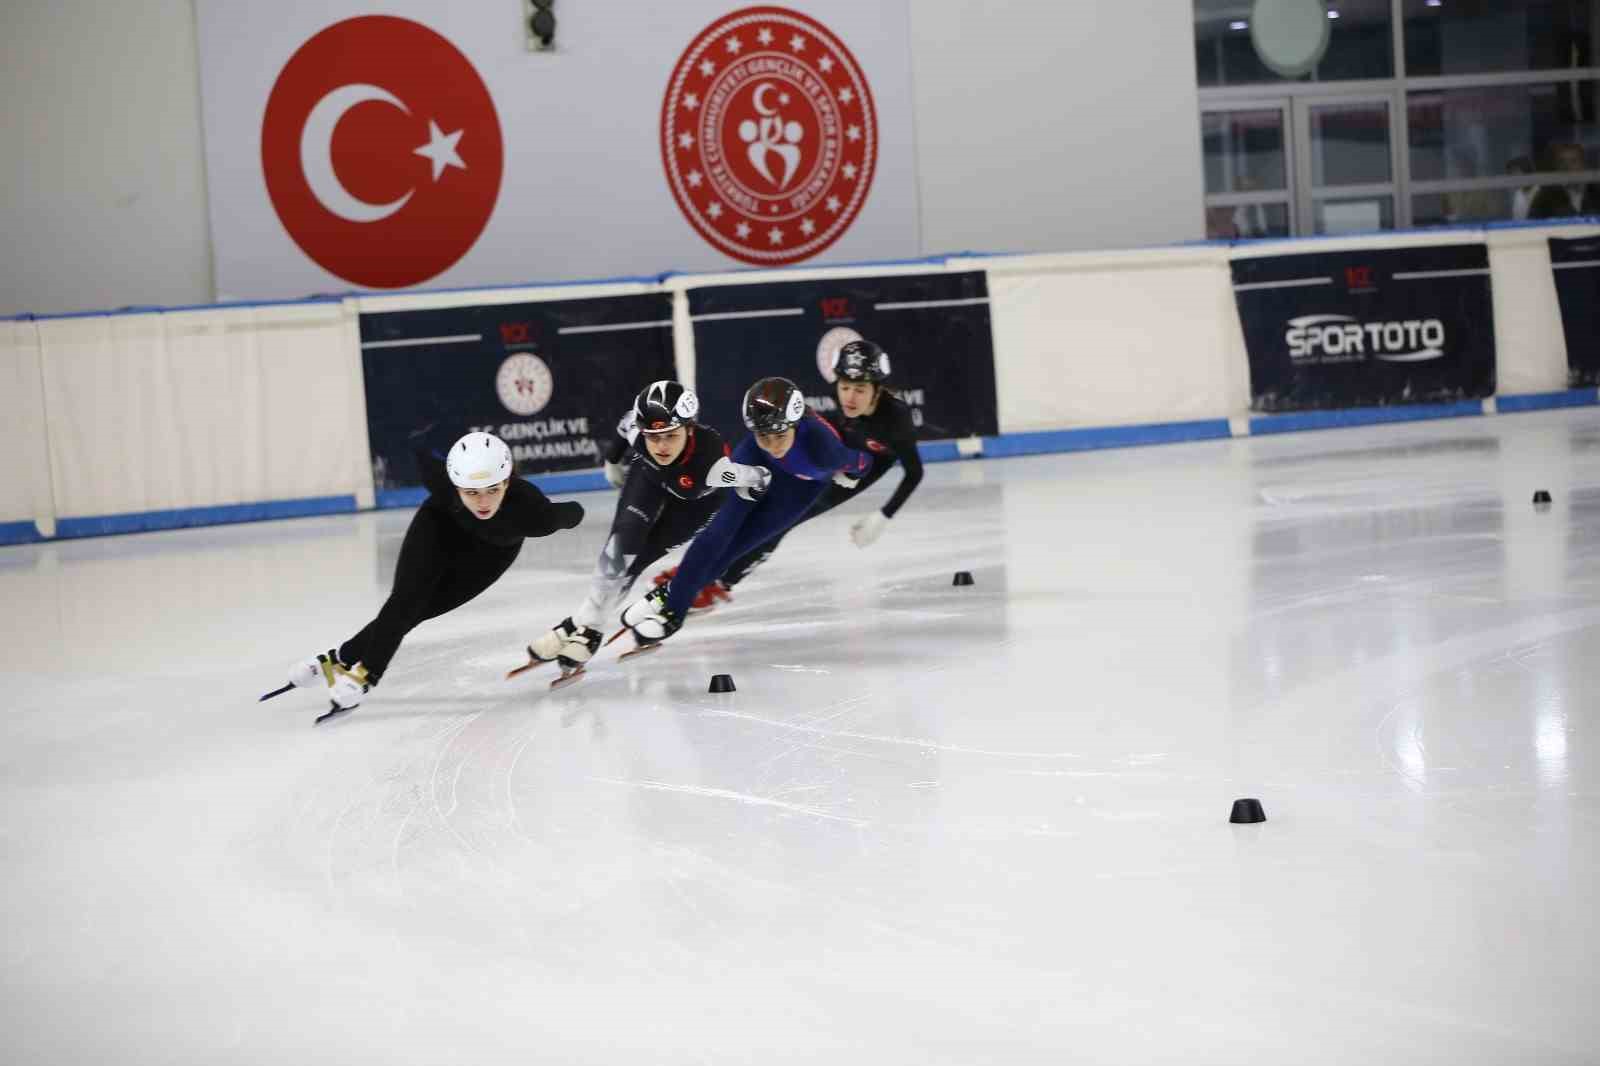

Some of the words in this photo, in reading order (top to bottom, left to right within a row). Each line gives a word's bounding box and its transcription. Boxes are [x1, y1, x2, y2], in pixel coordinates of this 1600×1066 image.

[747, 58, 806, 81] GENÇLİK
[903, 389, 924, 405] VE
[500, 418, 567, 441] GENÇLİK
[567, 417, 588, 435] VE
